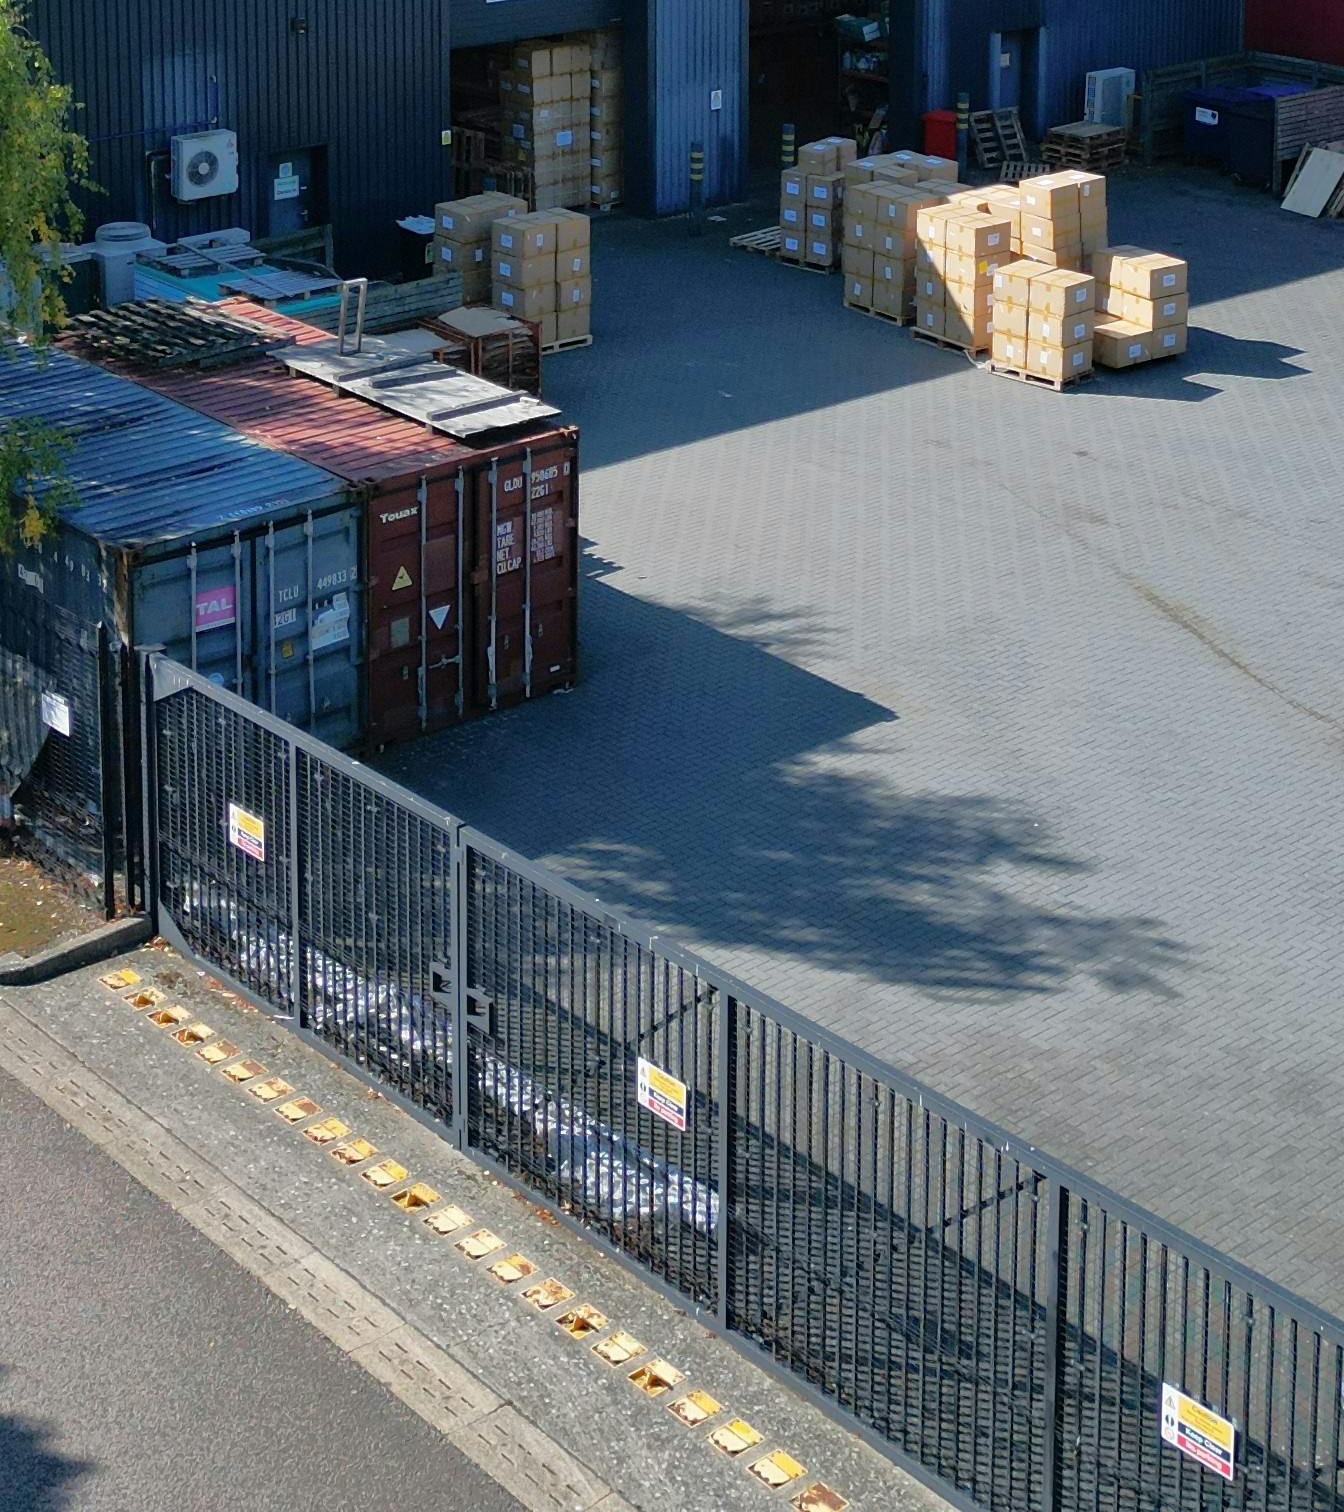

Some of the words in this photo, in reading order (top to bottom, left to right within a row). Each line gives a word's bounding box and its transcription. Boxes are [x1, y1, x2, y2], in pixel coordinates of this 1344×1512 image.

[379, 506, 418, 524] Touax
[497, 548, 510, 562] NET
[278, 585, 299, 603] TCLU
[316, 569, 348, 590] 449833
[195, 598, 233, 616] TAL
[1184, 1427, 1204, 1444] Keep
[1204, 1438, 1223, 1456] Clear
